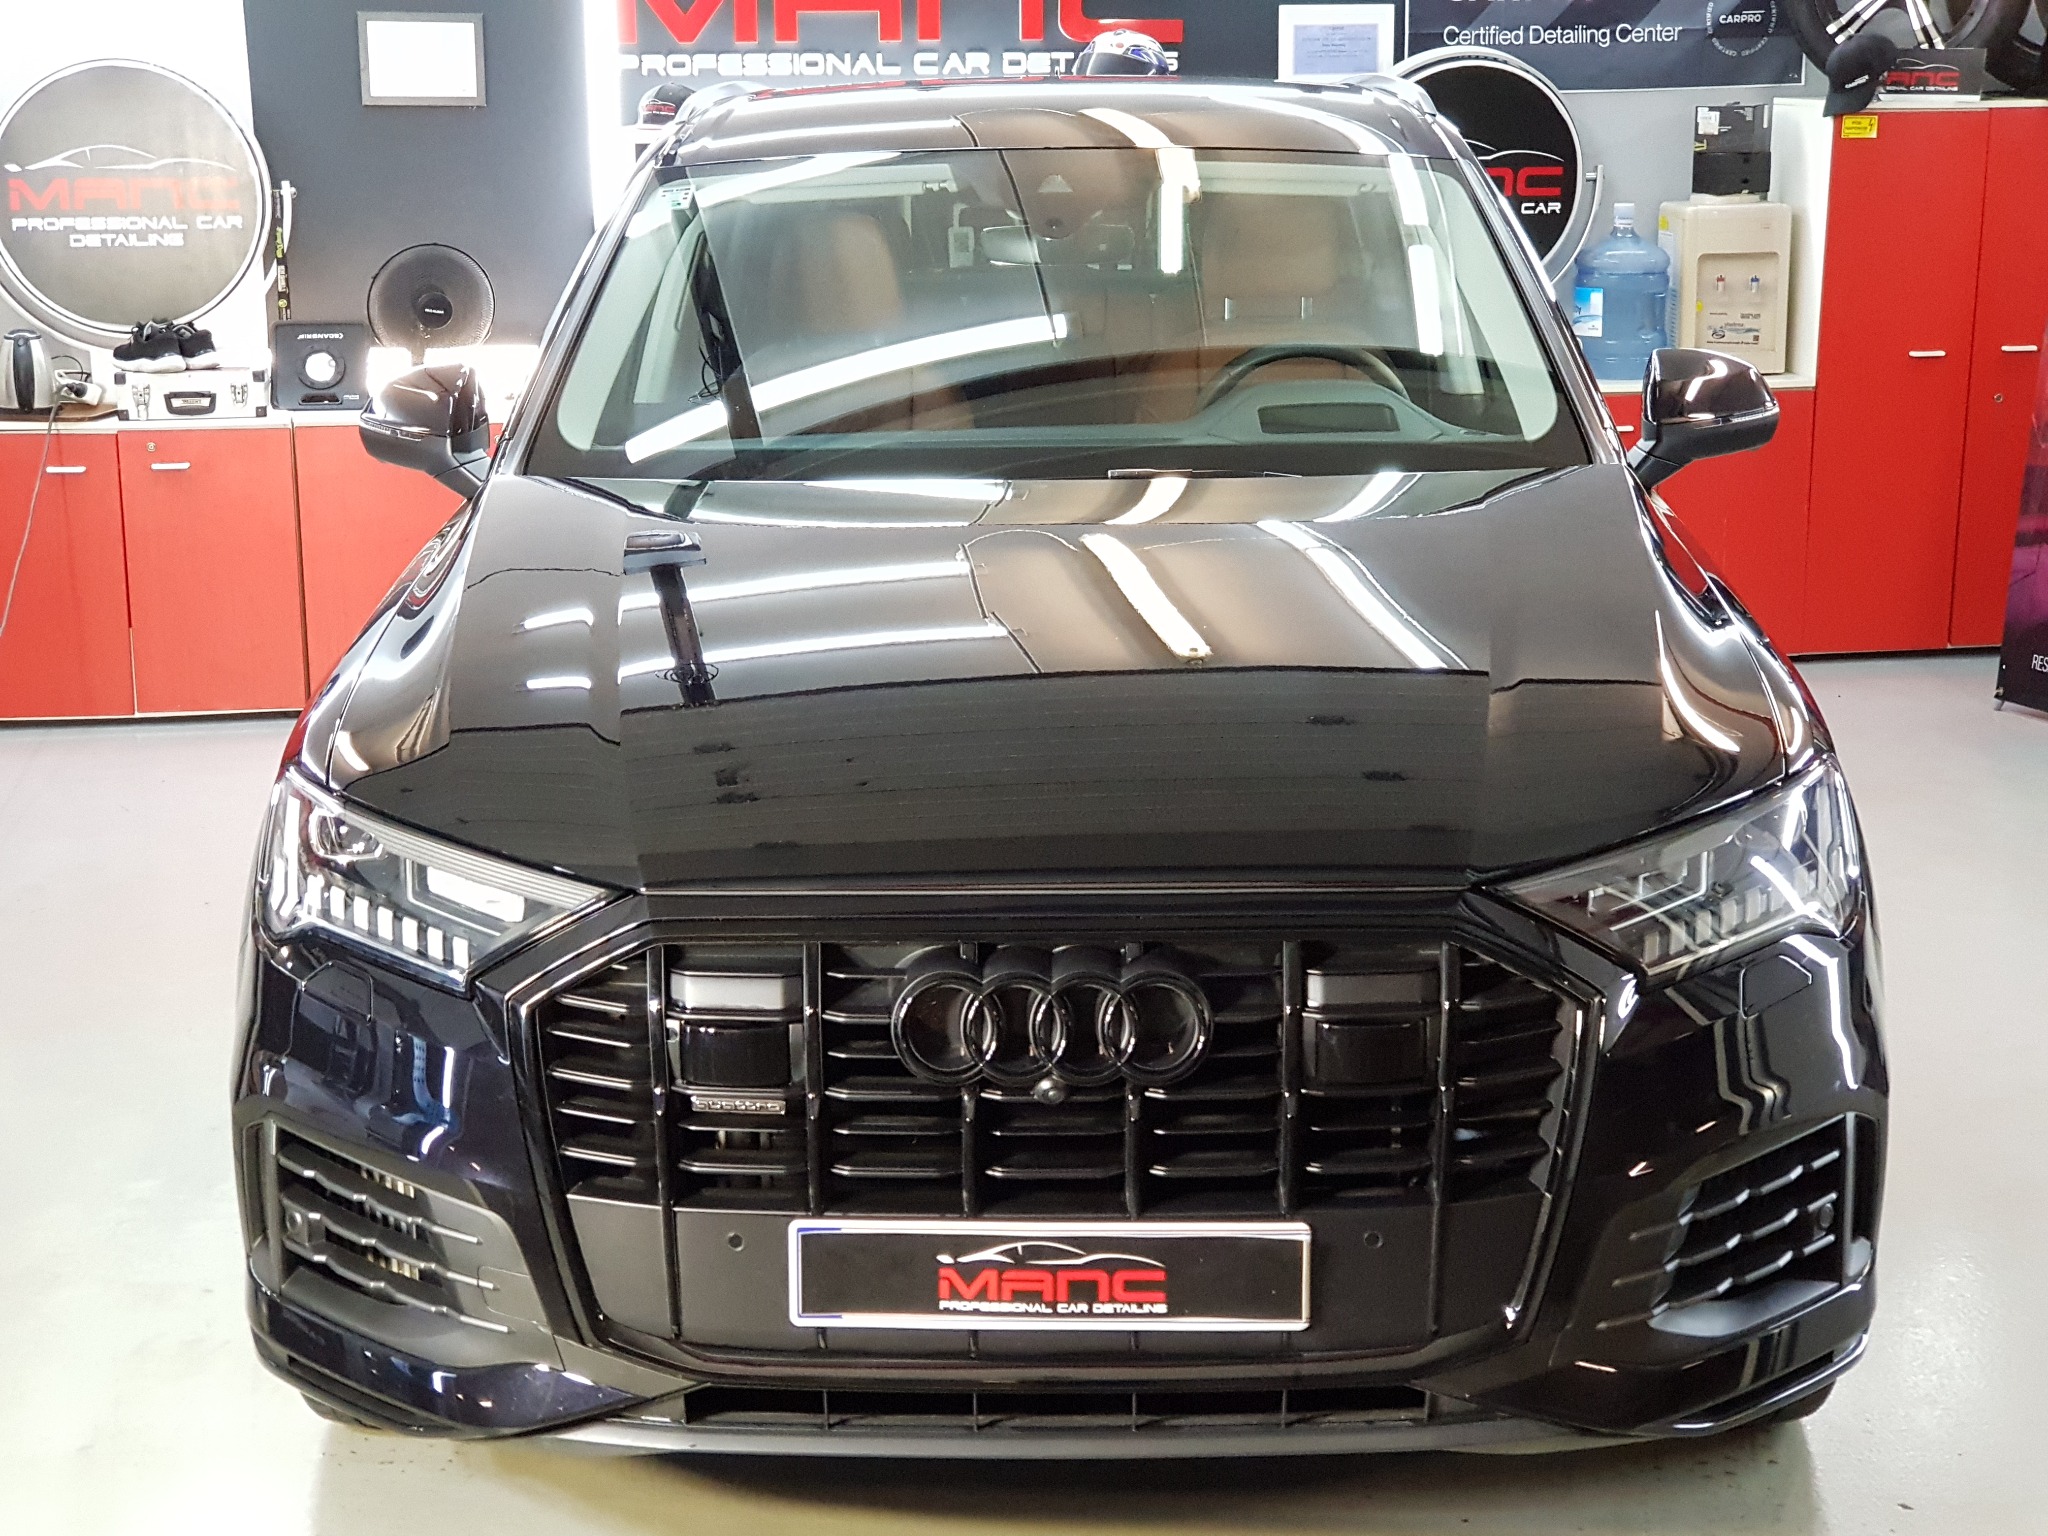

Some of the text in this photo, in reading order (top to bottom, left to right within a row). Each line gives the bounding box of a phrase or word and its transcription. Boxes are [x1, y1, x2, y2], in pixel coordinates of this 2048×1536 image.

[1719, 14, 1762, 24] CARPRO
[1443, 22, 1683, 47] Certified Detailing Center
[619, 52, 901, 77] PROFESSIONAL
[913, 51, 991, 76] CAR
[1886, 71, 1960, 86] ANC
[1485, 167, 1563, 196] NC
[8, 178, 241, 211] MANC
[1520, 202, 1562, 215] CAR
[11, 215, 243, 232] PROFESSIONAL CAR
[69, 233, 185, 248] DETAILING
[938, 1267, 1167, 1303] MANC
[938, 1300, 1168, 1314] PROFESSIONAL CAR DETAILING
